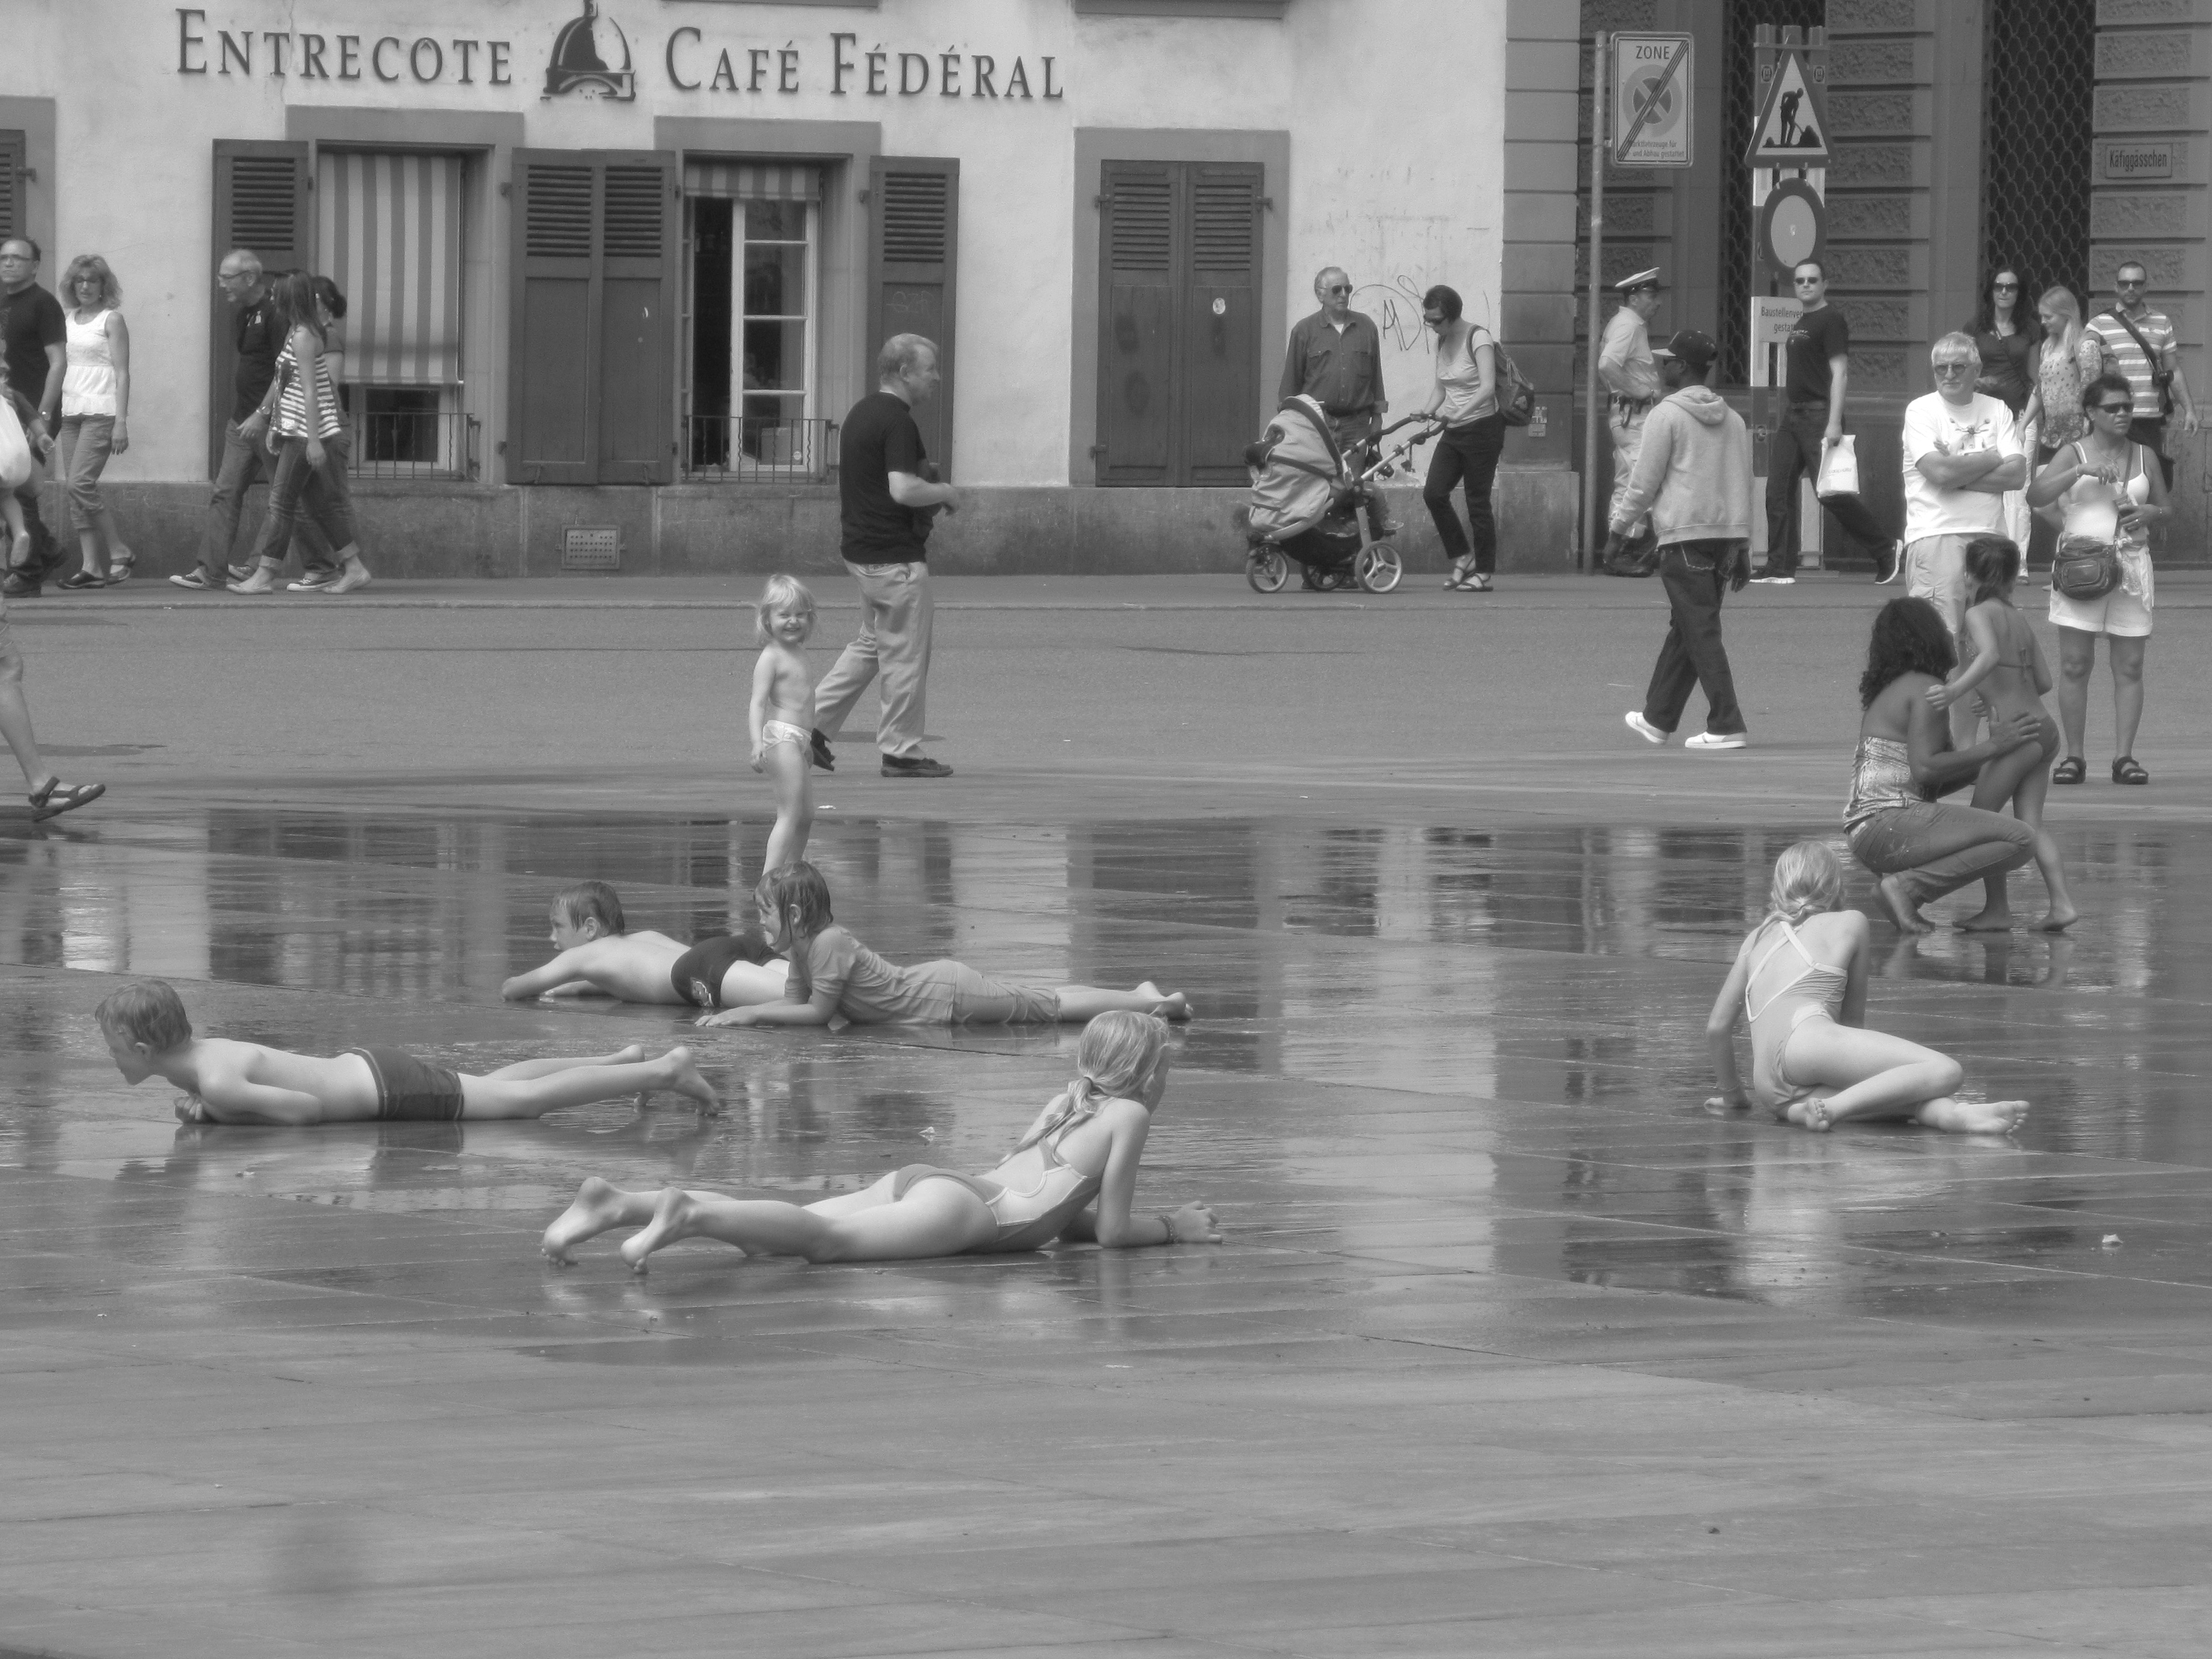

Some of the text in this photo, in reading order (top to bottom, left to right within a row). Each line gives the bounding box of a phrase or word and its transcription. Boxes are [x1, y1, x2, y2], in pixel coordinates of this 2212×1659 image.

[665, 27, 800, 93] CAFÉ
[830, 33, 1064, 98] FÉDÉRAL
[1635, 45, 1671, 59] ZONE
[2110, 149, 2167, 172] Käfiggässchen
